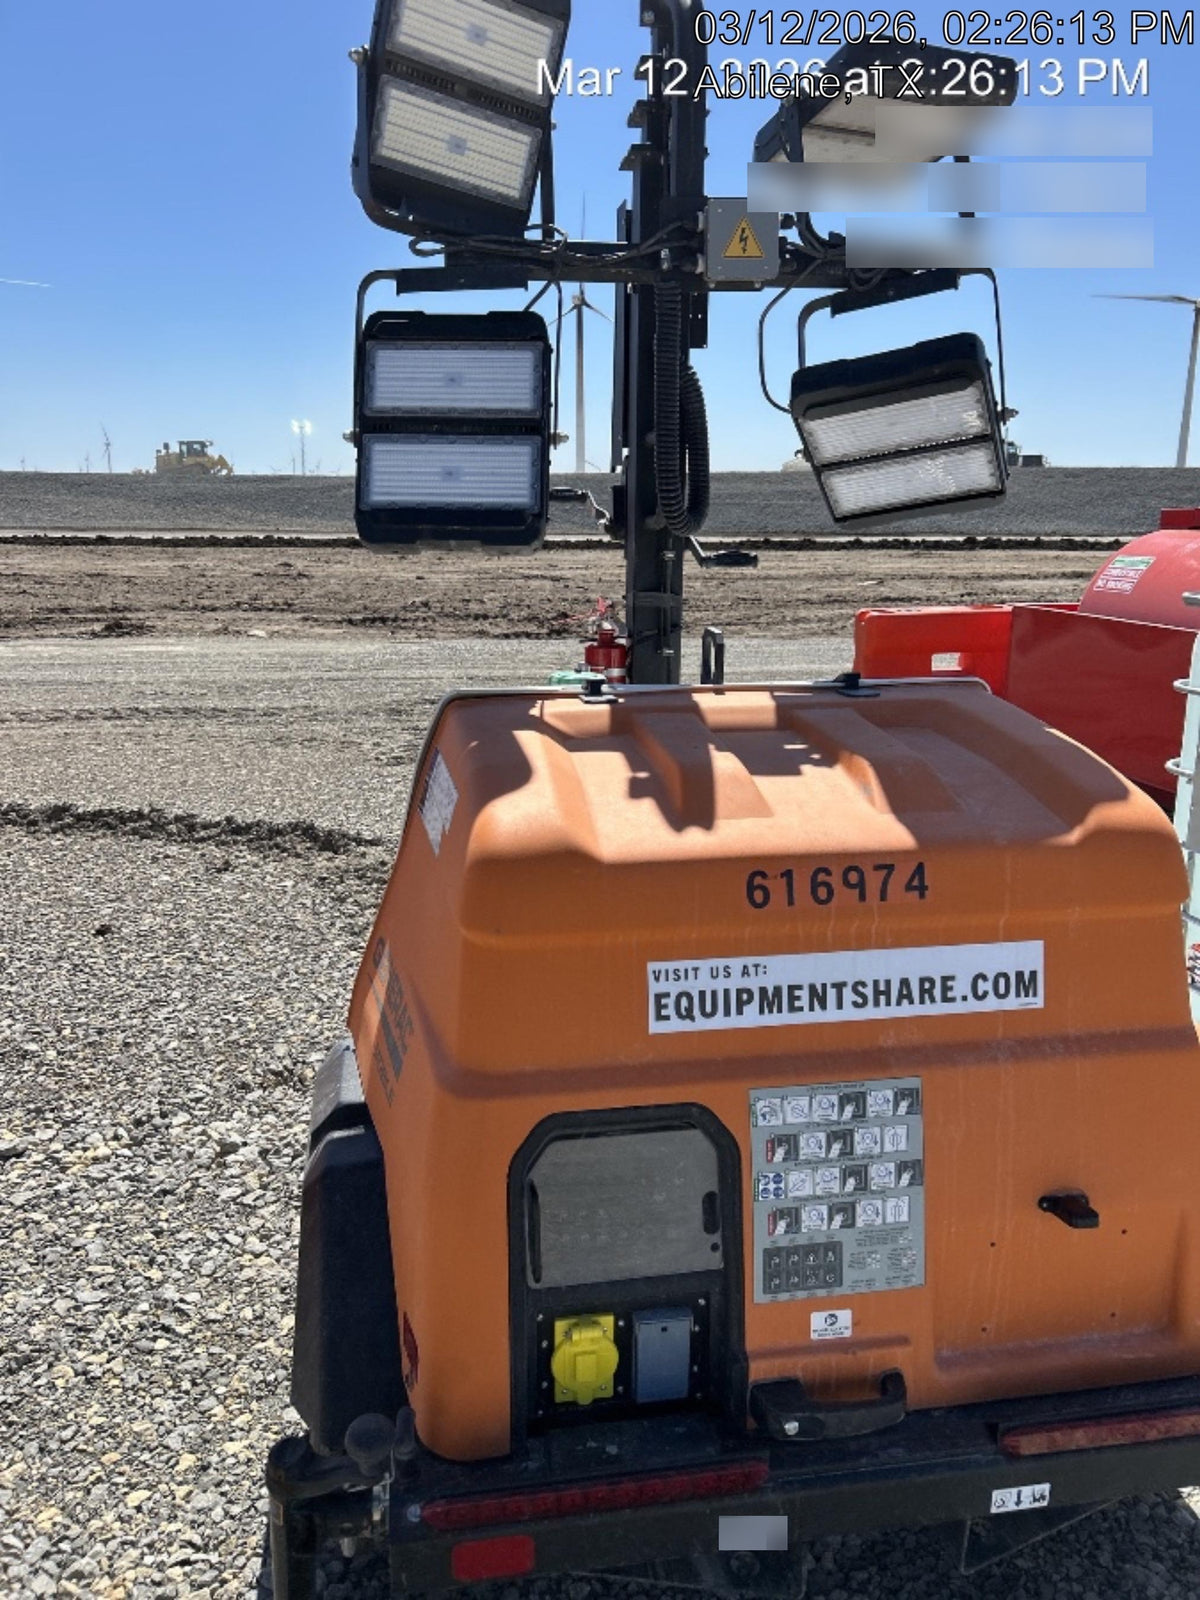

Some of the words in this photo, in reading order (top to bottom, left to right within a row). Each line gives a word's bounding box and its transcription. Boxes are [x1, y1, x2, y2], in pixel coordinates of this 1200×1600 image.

[746, 862, 929, 909] 616974
[652, 966, 700, 983] VISIT
[710, 964, 731, 979] US
[741, 963, 767, 978] AT:
[653, 969, 1039, 1023] EQUIPMENTSHARE.COM
